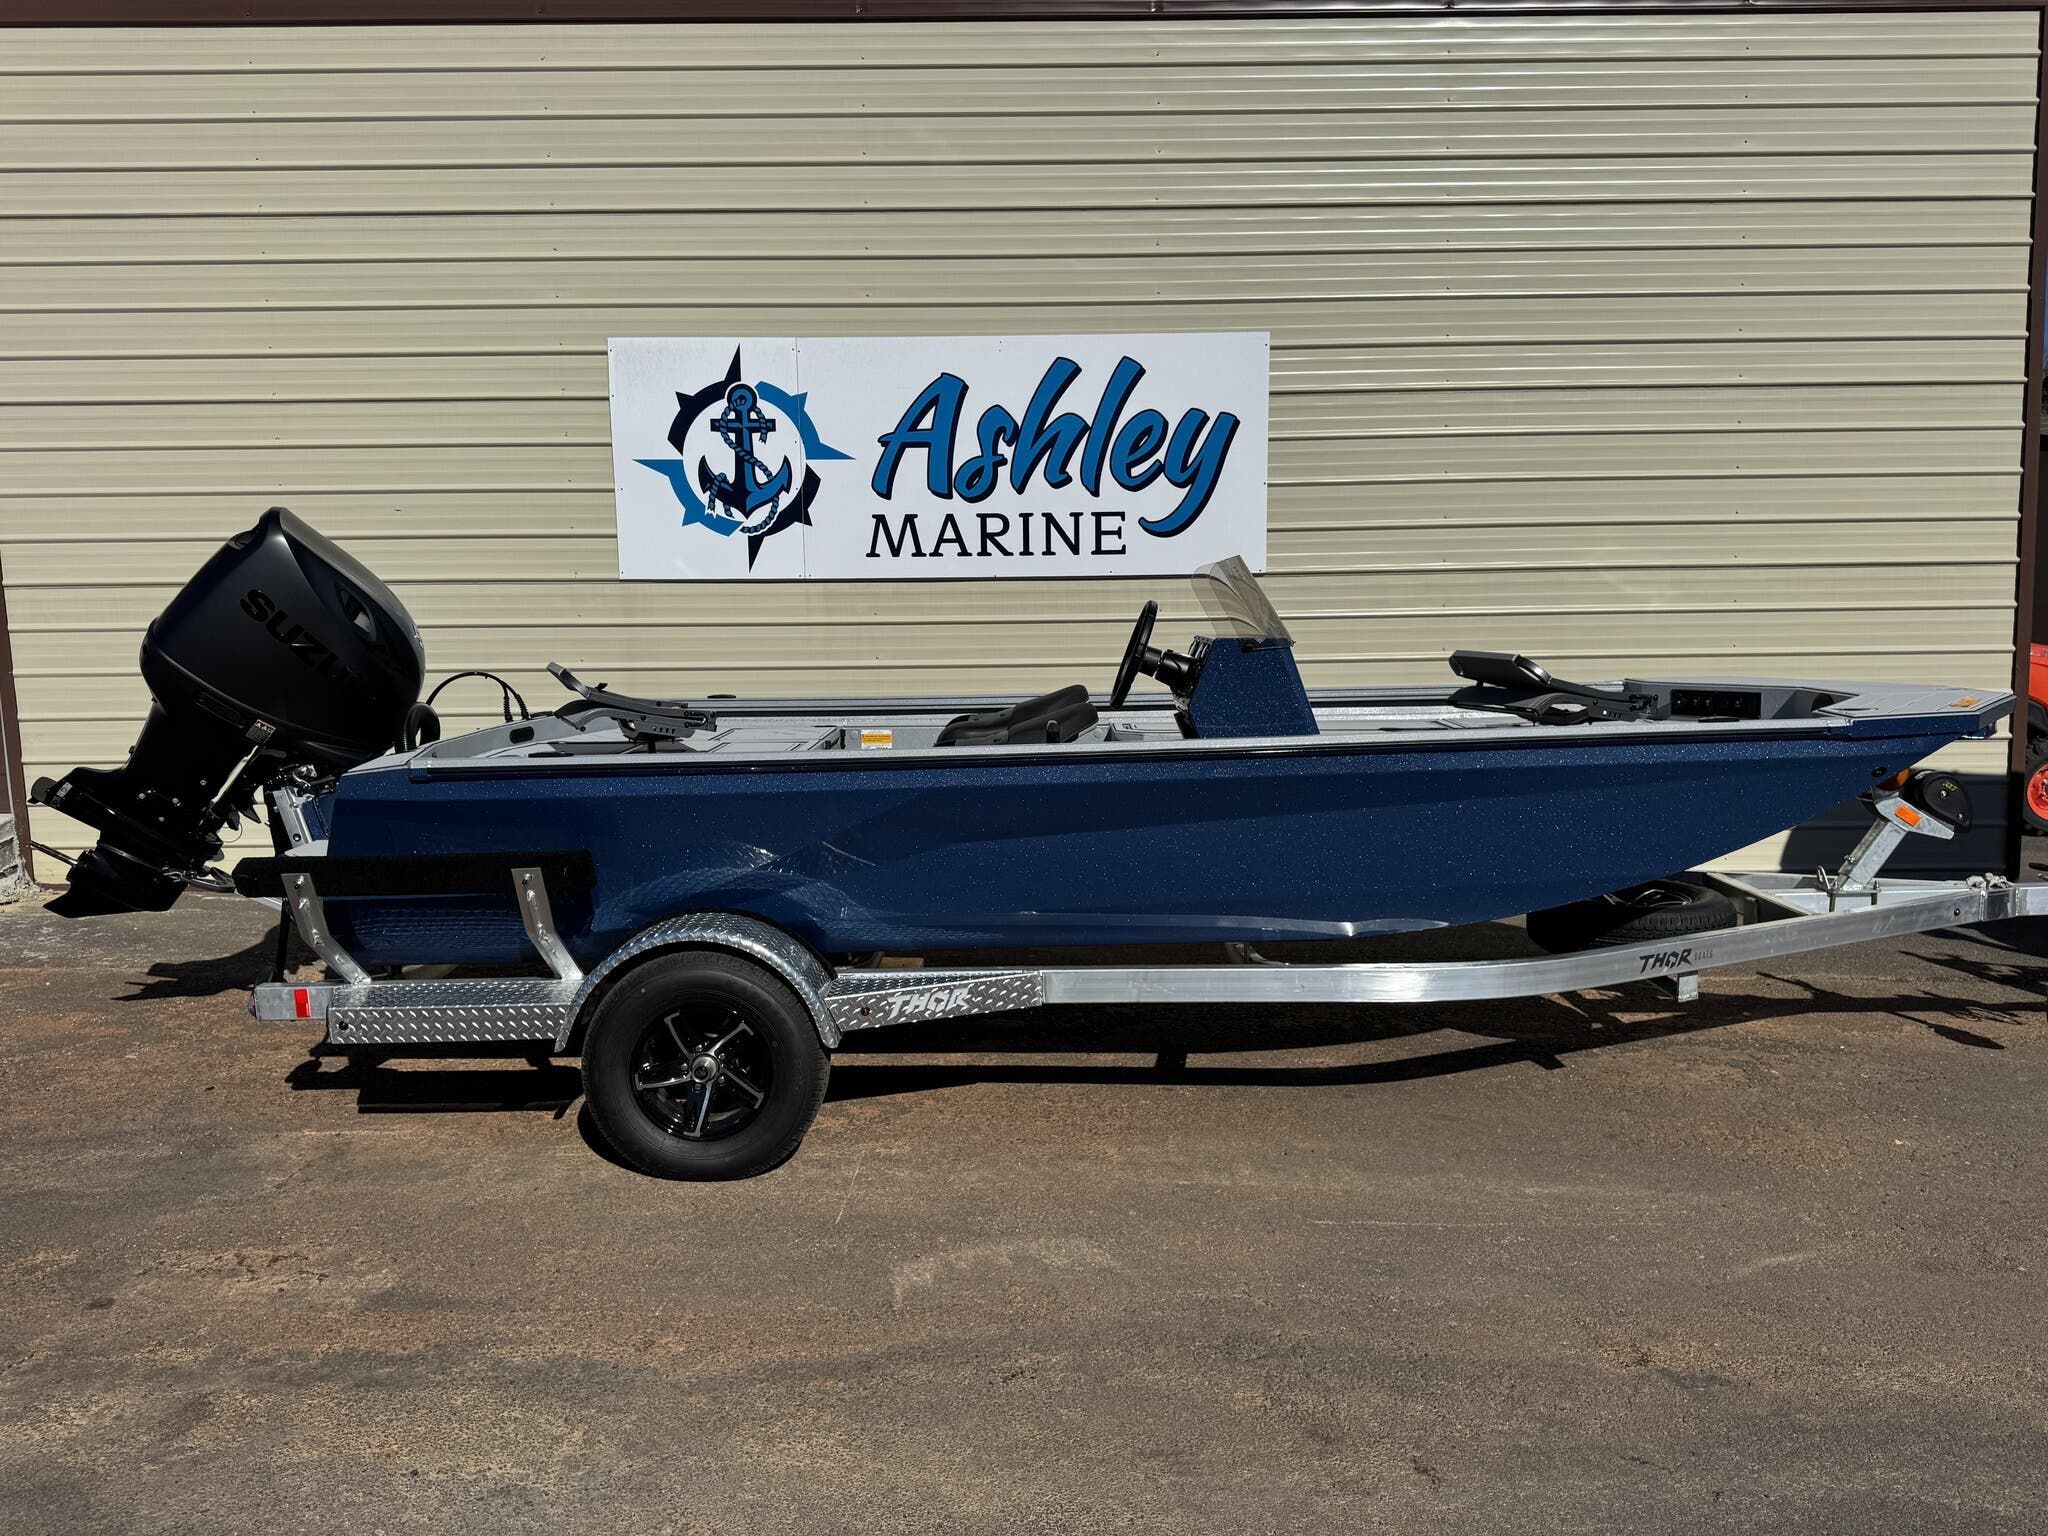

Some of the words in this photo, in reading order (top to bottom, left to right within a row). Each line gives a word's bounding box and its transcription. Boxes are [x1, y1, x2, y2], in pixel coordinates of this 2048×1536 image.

[871, 356, 1240, 538] Ashley
[866, 512, 1127, 558] MARINE
[240, 589, 366, 693] SUZU
[1640, 948, 1693, 974] THOR
[887, 988, 970, 1021] THOR
